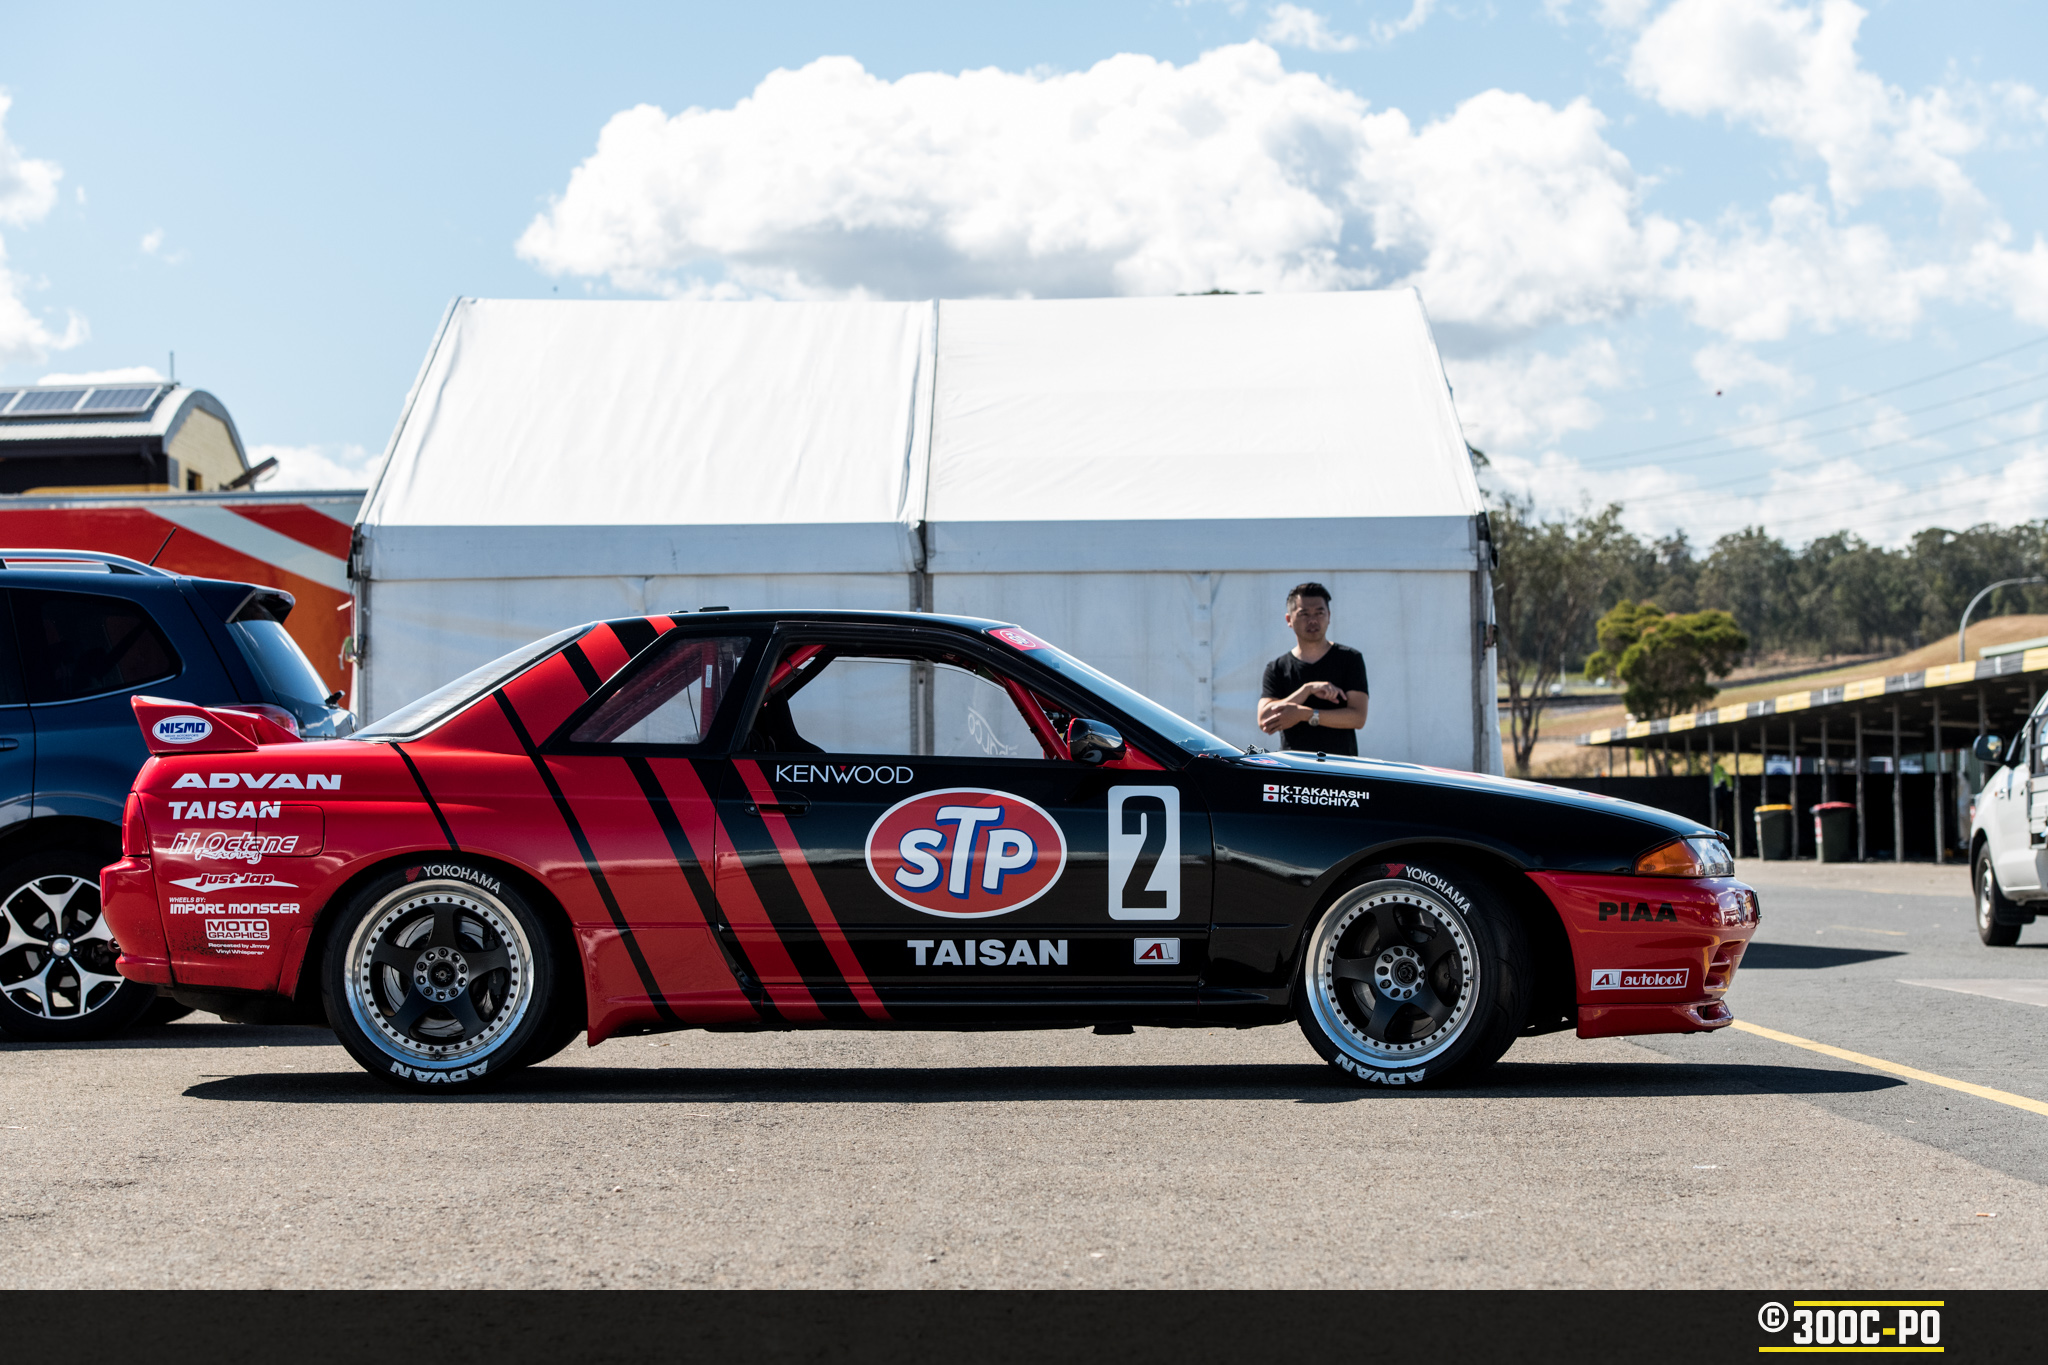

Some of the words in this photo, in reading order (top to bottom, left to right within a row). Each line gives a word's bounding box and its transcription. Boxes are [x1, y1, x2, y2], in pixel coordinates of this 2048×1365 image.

[159, 722, 206, 734] NISMO
[171, 773, 342, 790] ADVAN
[776, 764, 914, 784] KENWOOD
[1280, 785, 1370, 800] K.TAKAHASHI
[1280, 794, 1360, 808] K.TSUCHIYA
[168, 801, 281, 820] TAISAN
[893, 805, 1038, 900] STP
[1121, 796, 1167, 909] 2
[422, 864, 501, 895] YOKOHAMA
[1405, 865, 1471, 915] YOKOHAMA
[169, 903, 226, 915] IMPORT
[1598, 902, 1678, 922] PIAA
[207, 921, 267, 931] MOTO
[907, 939, 1068, 966] TAISAN
[1623, 973, 1683, 986] autolook
[389, 1060, 489, 1083] ADVAN
[1334, 1053, 1426, 1085] ADVAN
